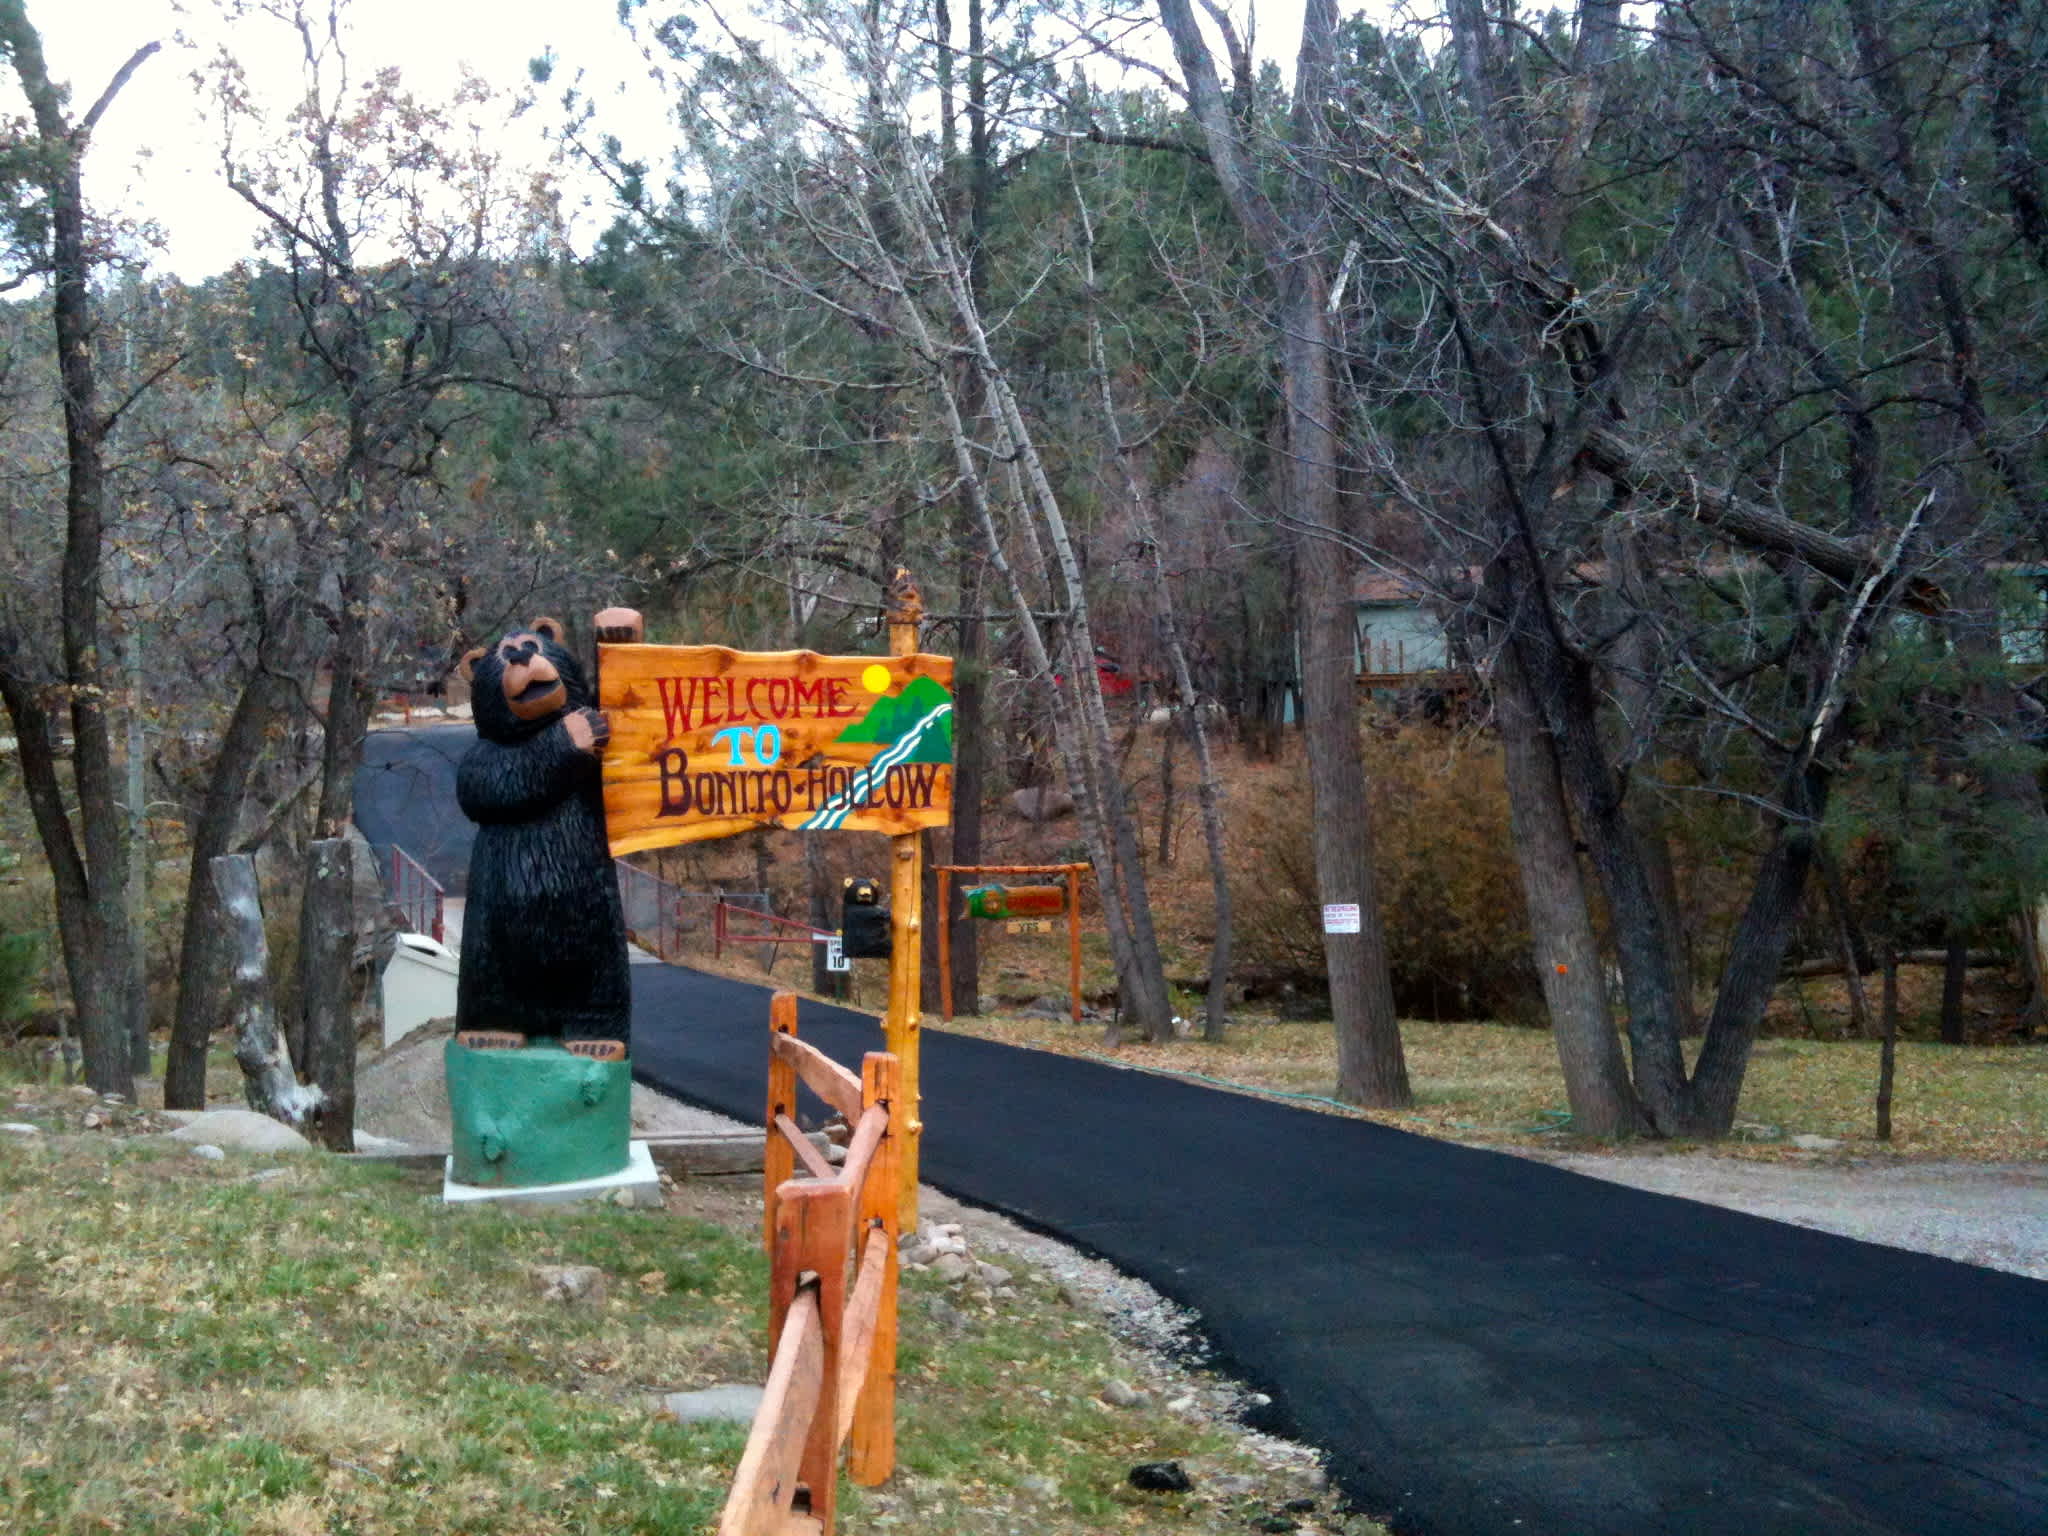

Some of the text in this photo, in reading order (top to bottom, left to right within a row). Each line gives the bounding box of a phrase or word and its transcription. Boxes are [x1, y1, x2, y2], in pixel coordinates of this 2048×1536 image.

[655, 676, 863, 741] WELCOME
[711, 724, 782, 766] TO
[833, 955, 845, 969] 10
